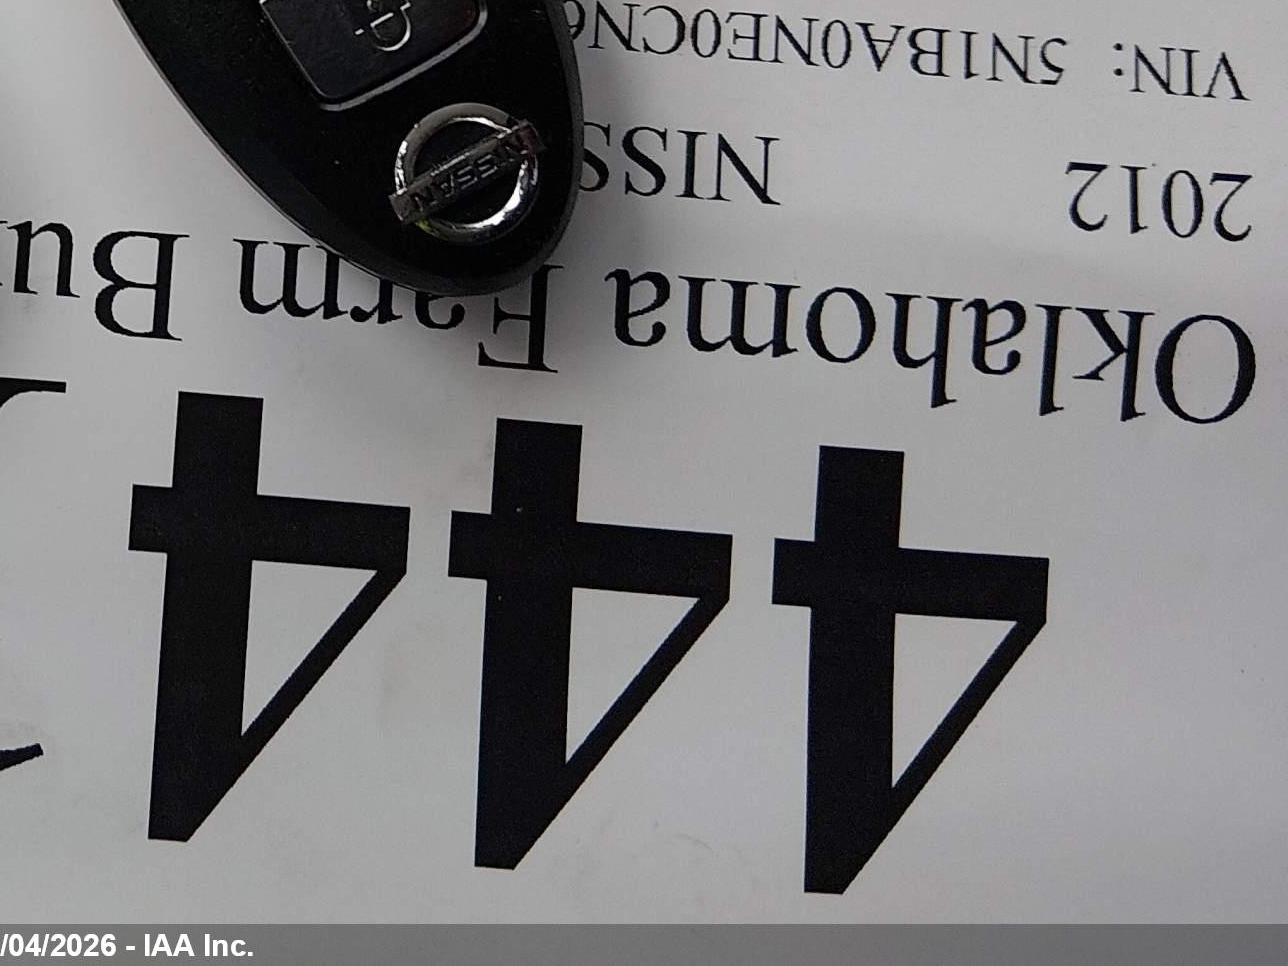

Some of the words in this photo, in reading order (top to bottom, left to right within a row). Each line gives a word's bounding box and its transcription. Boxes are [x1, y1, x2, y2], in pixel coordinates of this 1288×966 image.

[1113, 43, 1250, 102] VIN:
[412, 133, 530, 214] NISSAN
[1065, 162, 1254, 242] 2012
[604, 269, 1257, 425] Oklahoma
